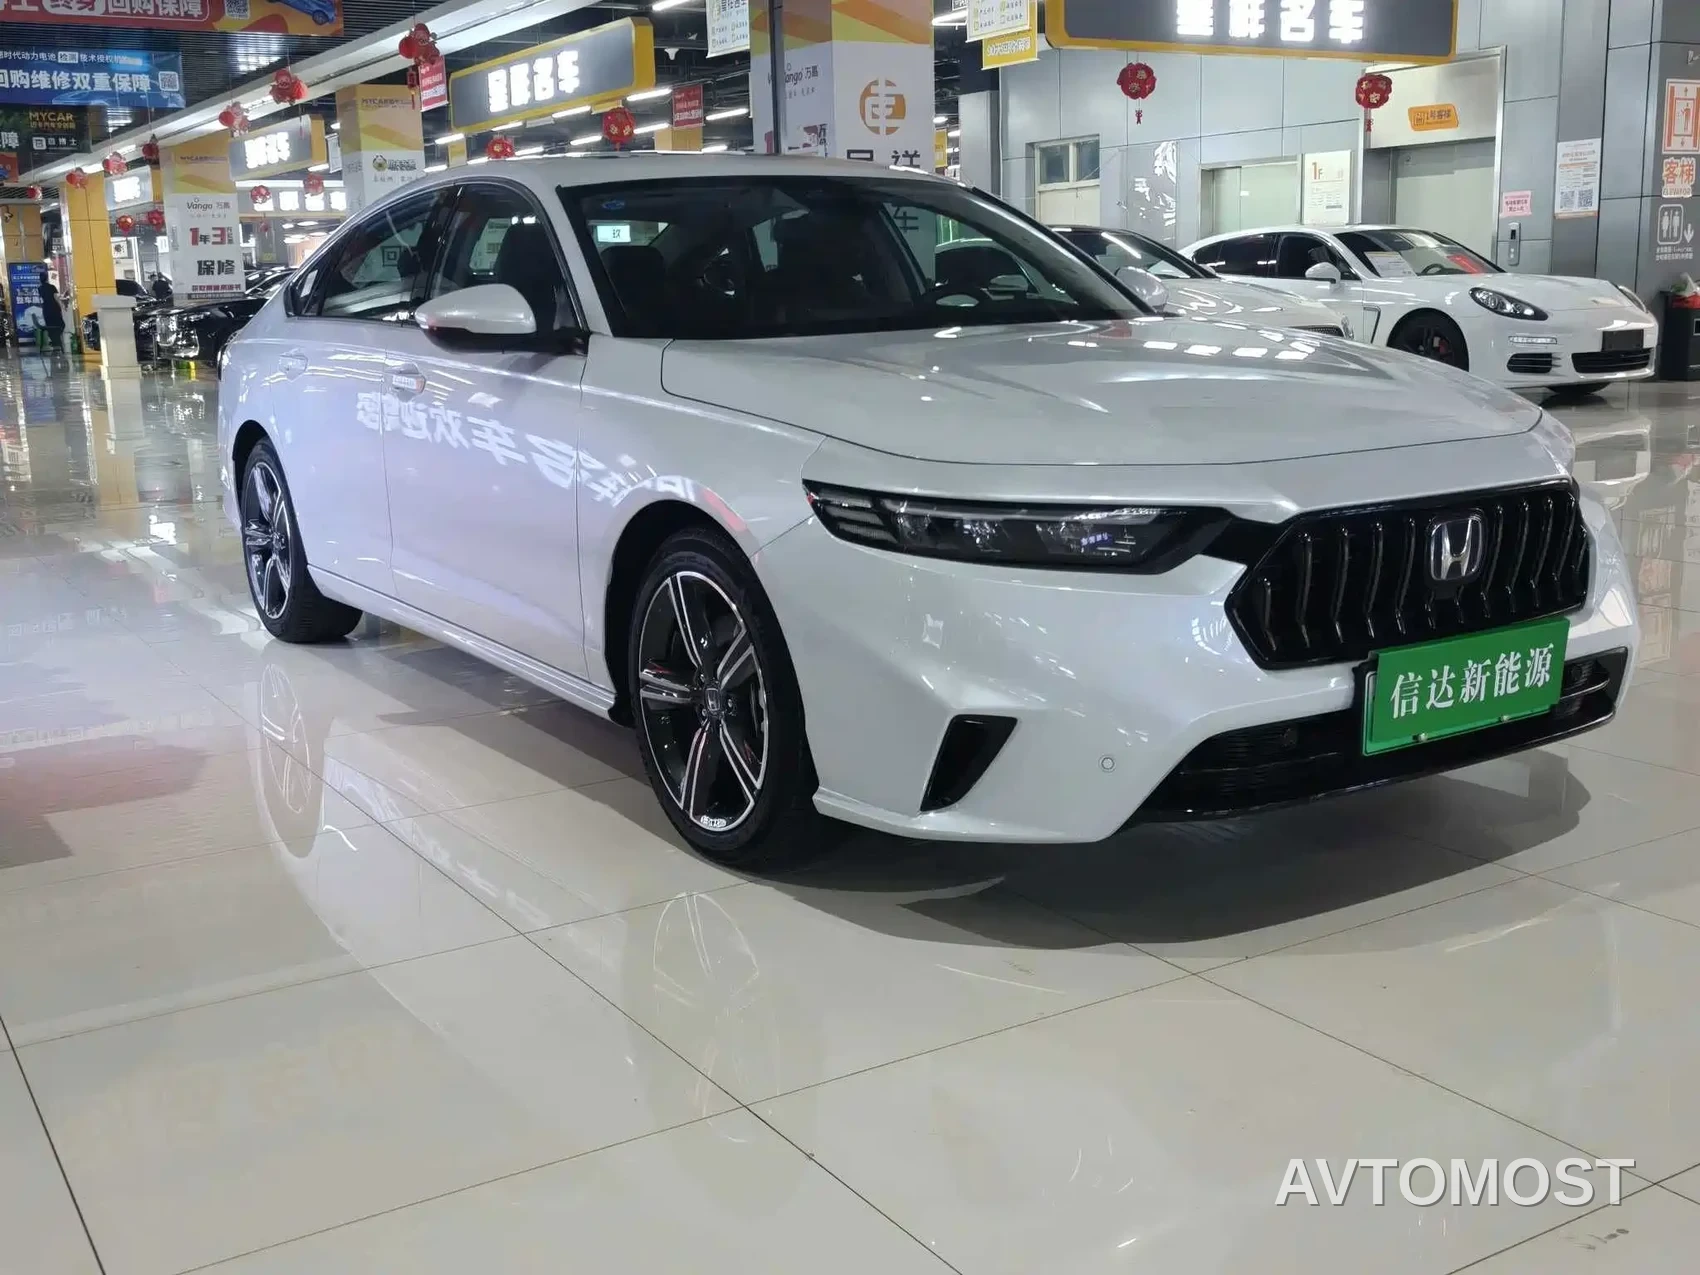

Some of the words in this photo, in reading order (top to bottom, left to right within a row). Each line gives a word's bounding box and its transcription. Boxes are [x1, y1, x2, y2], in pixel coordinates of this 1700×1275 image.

[28, 111, 74, 121] MYCAR
[1664, 160, 1694, 185] 客梯
[196, 259, 235, 277] 保修
[1390, 642, 1555, 719] 信达新能源
